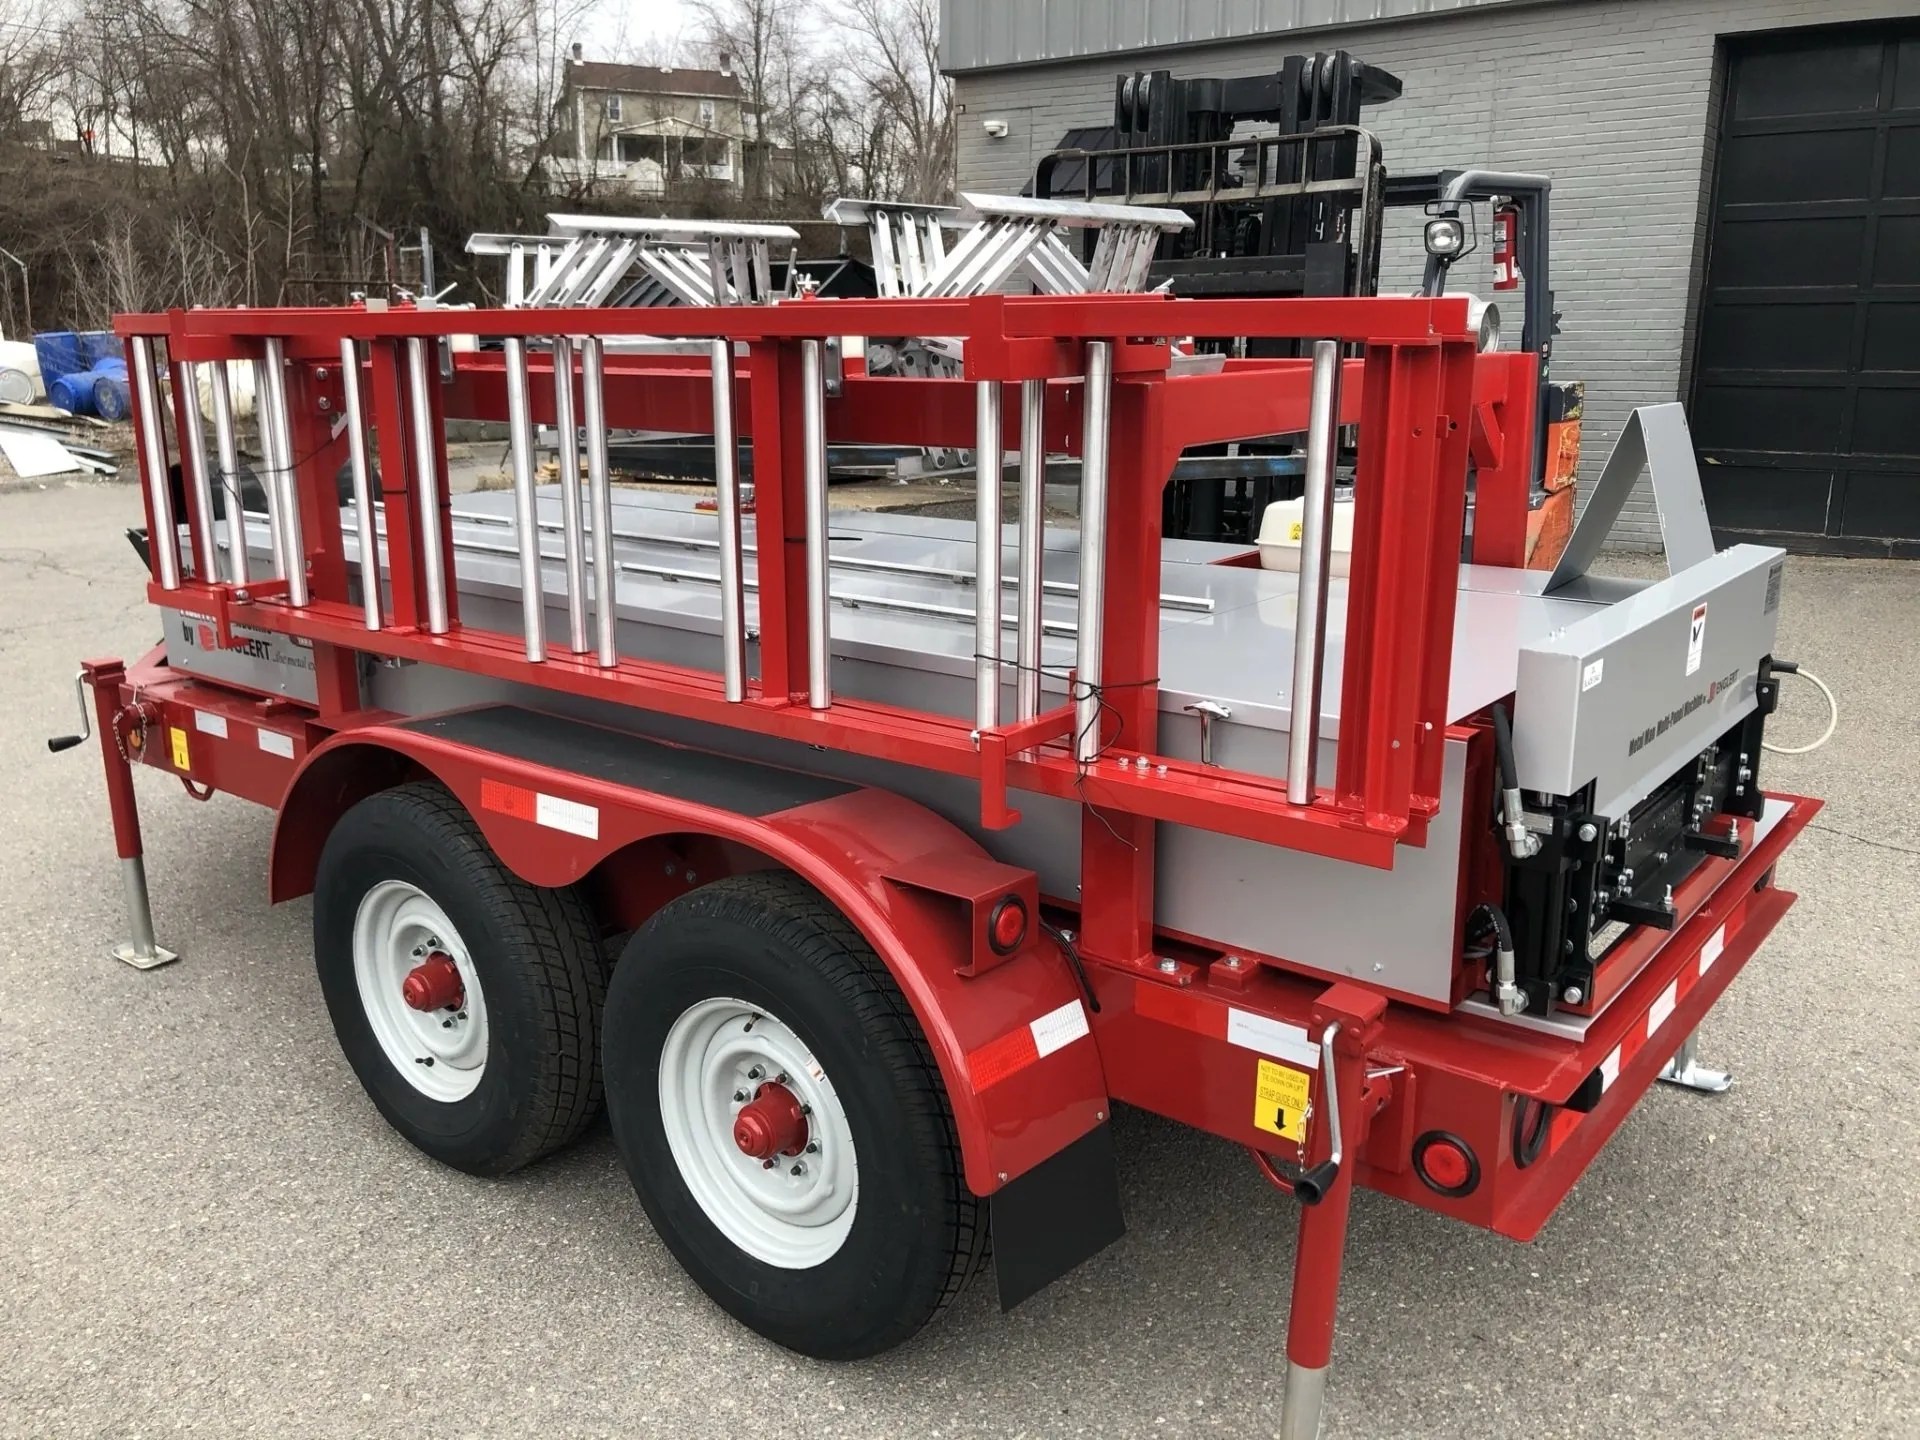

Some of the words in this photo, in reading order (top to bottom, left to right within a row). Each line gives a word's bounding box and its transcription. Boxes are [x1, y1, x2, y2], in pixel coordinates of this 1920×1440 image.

[182, 622, 194, 646] by
[216, 632, 270, 661] GLERT
[287, 655, 307, 669] metal
[1715, 668, 1739, 694] ENGLERT
[1628, 731, 1644, 757] Metal
[1656, 704, 1684, 737] Multi-Panel
[1269, 1075, 1285, 1087] DOWN
[1272, 1068, 1278, 1076] TO
[1279, 1070, 1285, 1078] BE
[1286, 1072, 1299, 1083] USED
[1260, 1086, 1275, 1098] STRAP
[1276, 1091, 1291, 1105] GUIDE
[1291, 1097, 1304, 1109] ONLY
